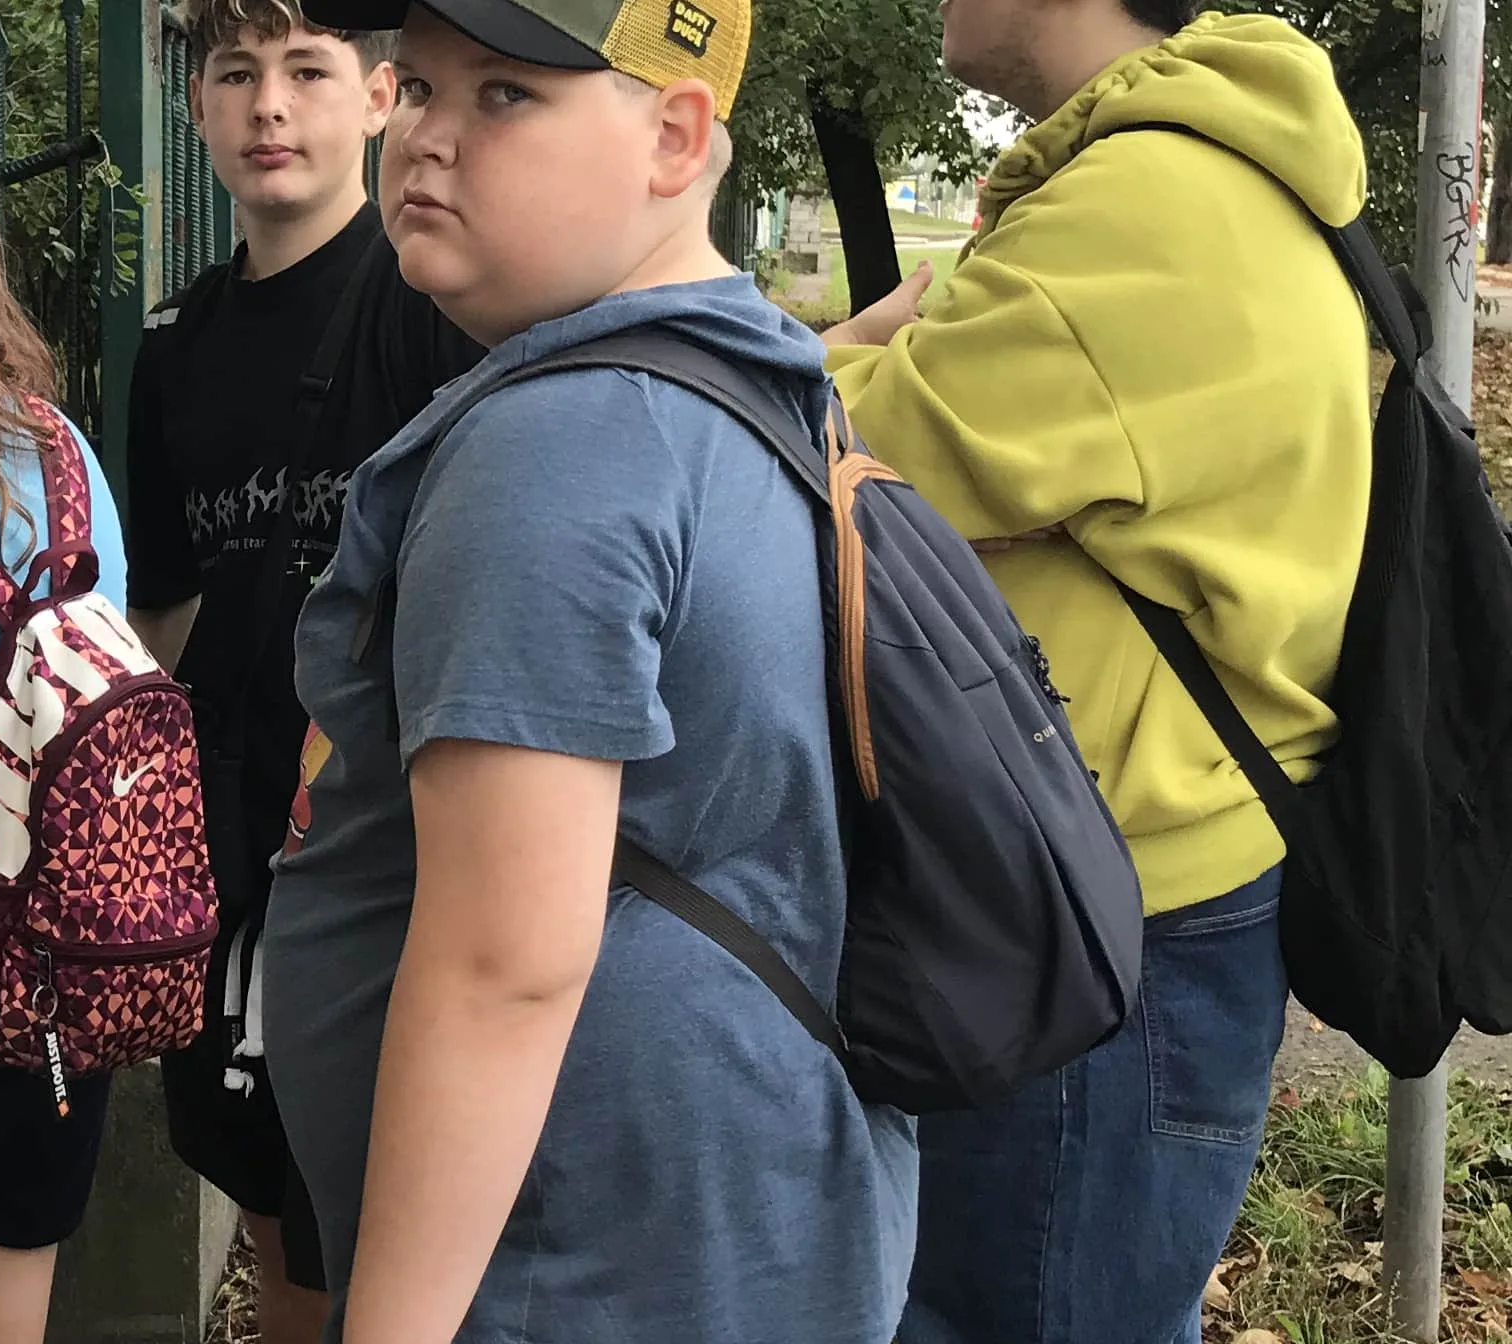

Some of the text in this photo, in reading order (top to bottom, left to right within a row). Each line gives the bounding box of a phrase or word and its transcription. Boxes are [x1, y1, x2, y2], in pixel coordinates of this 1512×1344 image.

[675, 1, 711, 33] DAFFY
[672, 18, 704, 48] DUCK
[45, 1031, 61, 1064] JUST
[51, 1062, 64, 1086] DO
